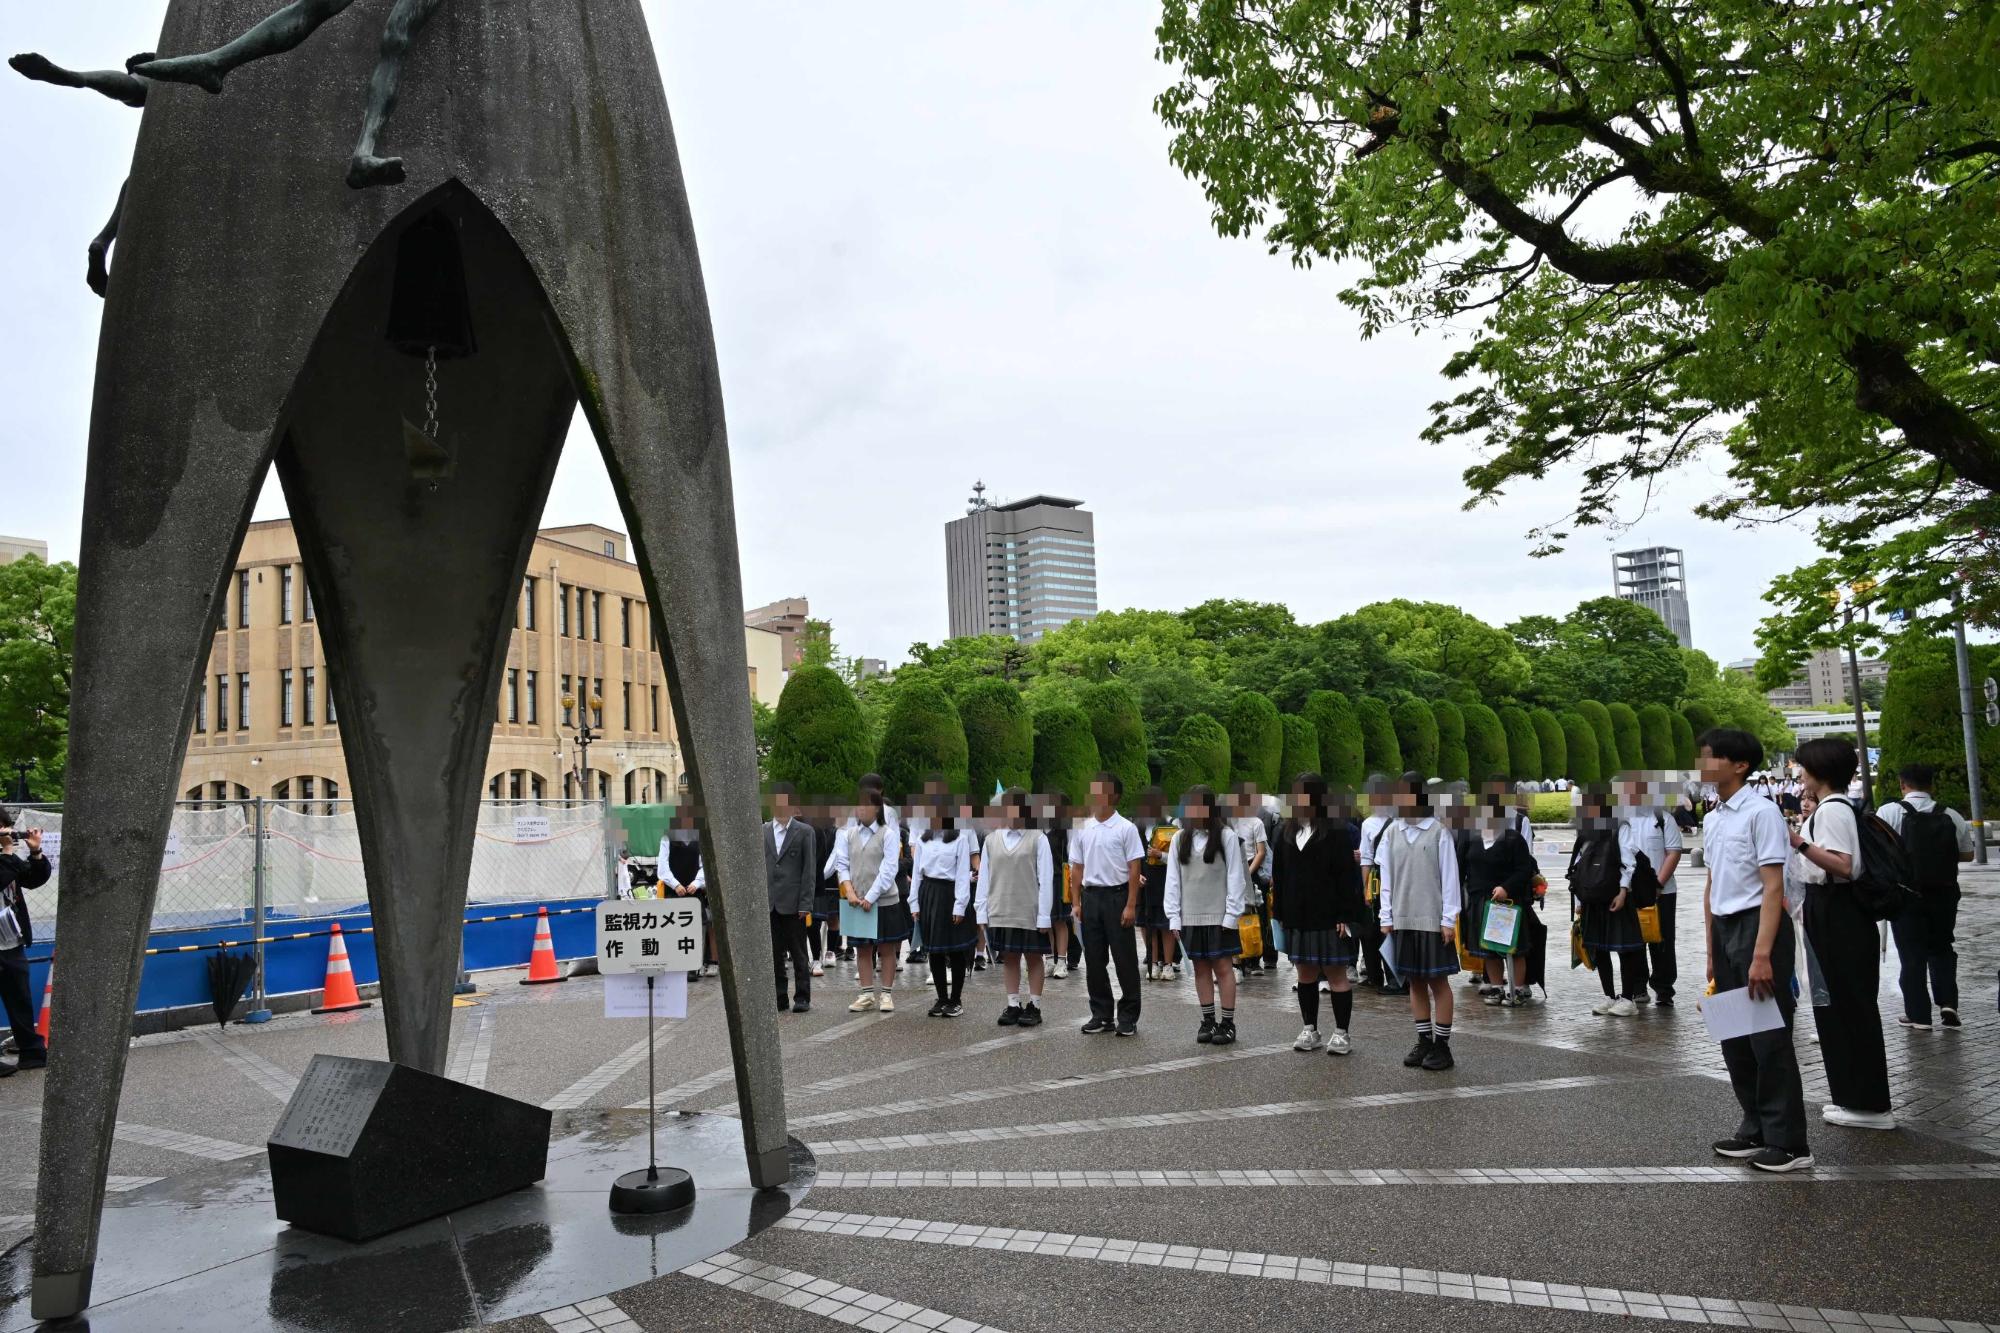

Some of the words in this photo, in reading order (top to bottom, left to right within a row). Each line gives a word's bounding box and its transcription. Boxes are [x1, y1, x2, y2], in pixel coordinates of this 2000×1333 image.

[605, 911, 694, 931] 監視カメラ
